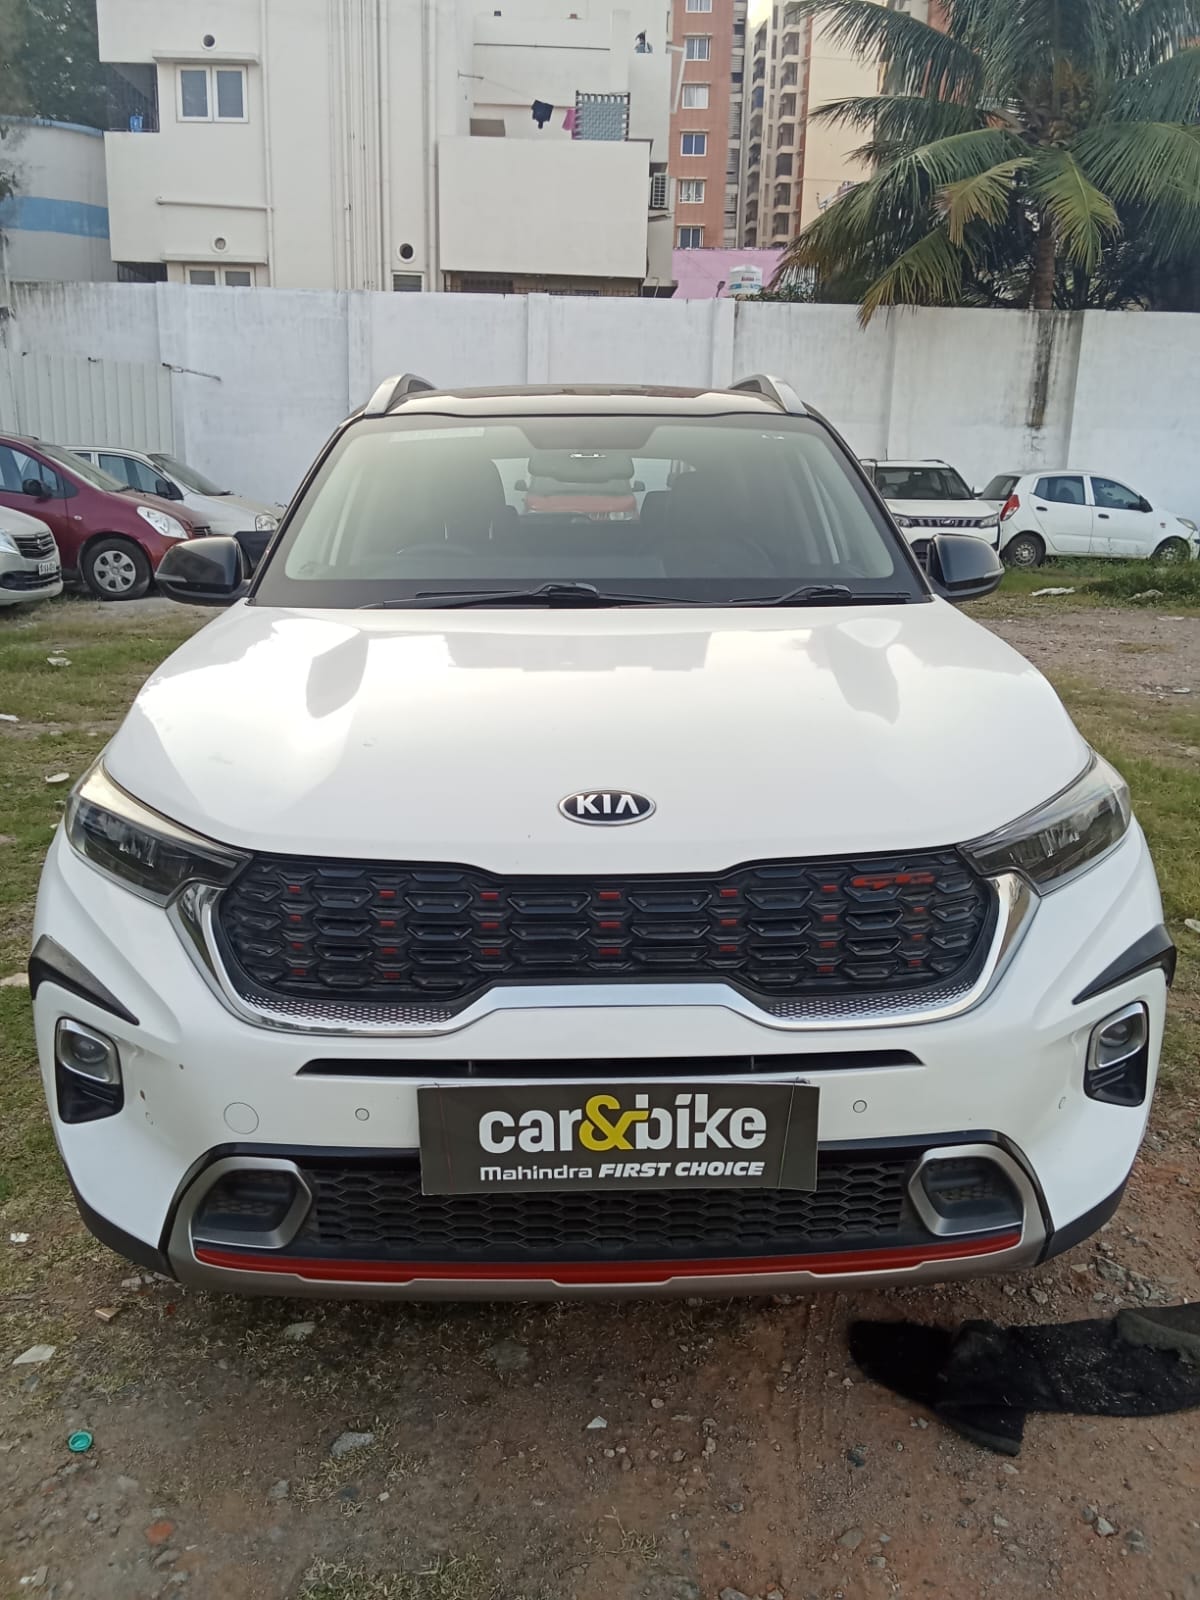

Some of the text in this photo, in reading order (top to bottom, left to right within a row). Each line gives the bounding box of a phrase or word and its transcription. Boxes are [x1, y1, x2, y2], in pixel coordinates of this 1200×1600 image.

[576, 794, 640, 815] KIA
[478, 1093, 767, 1153] car&bike
[480, 1161, 765, 1181] Mahindra FIRST CHOICE
